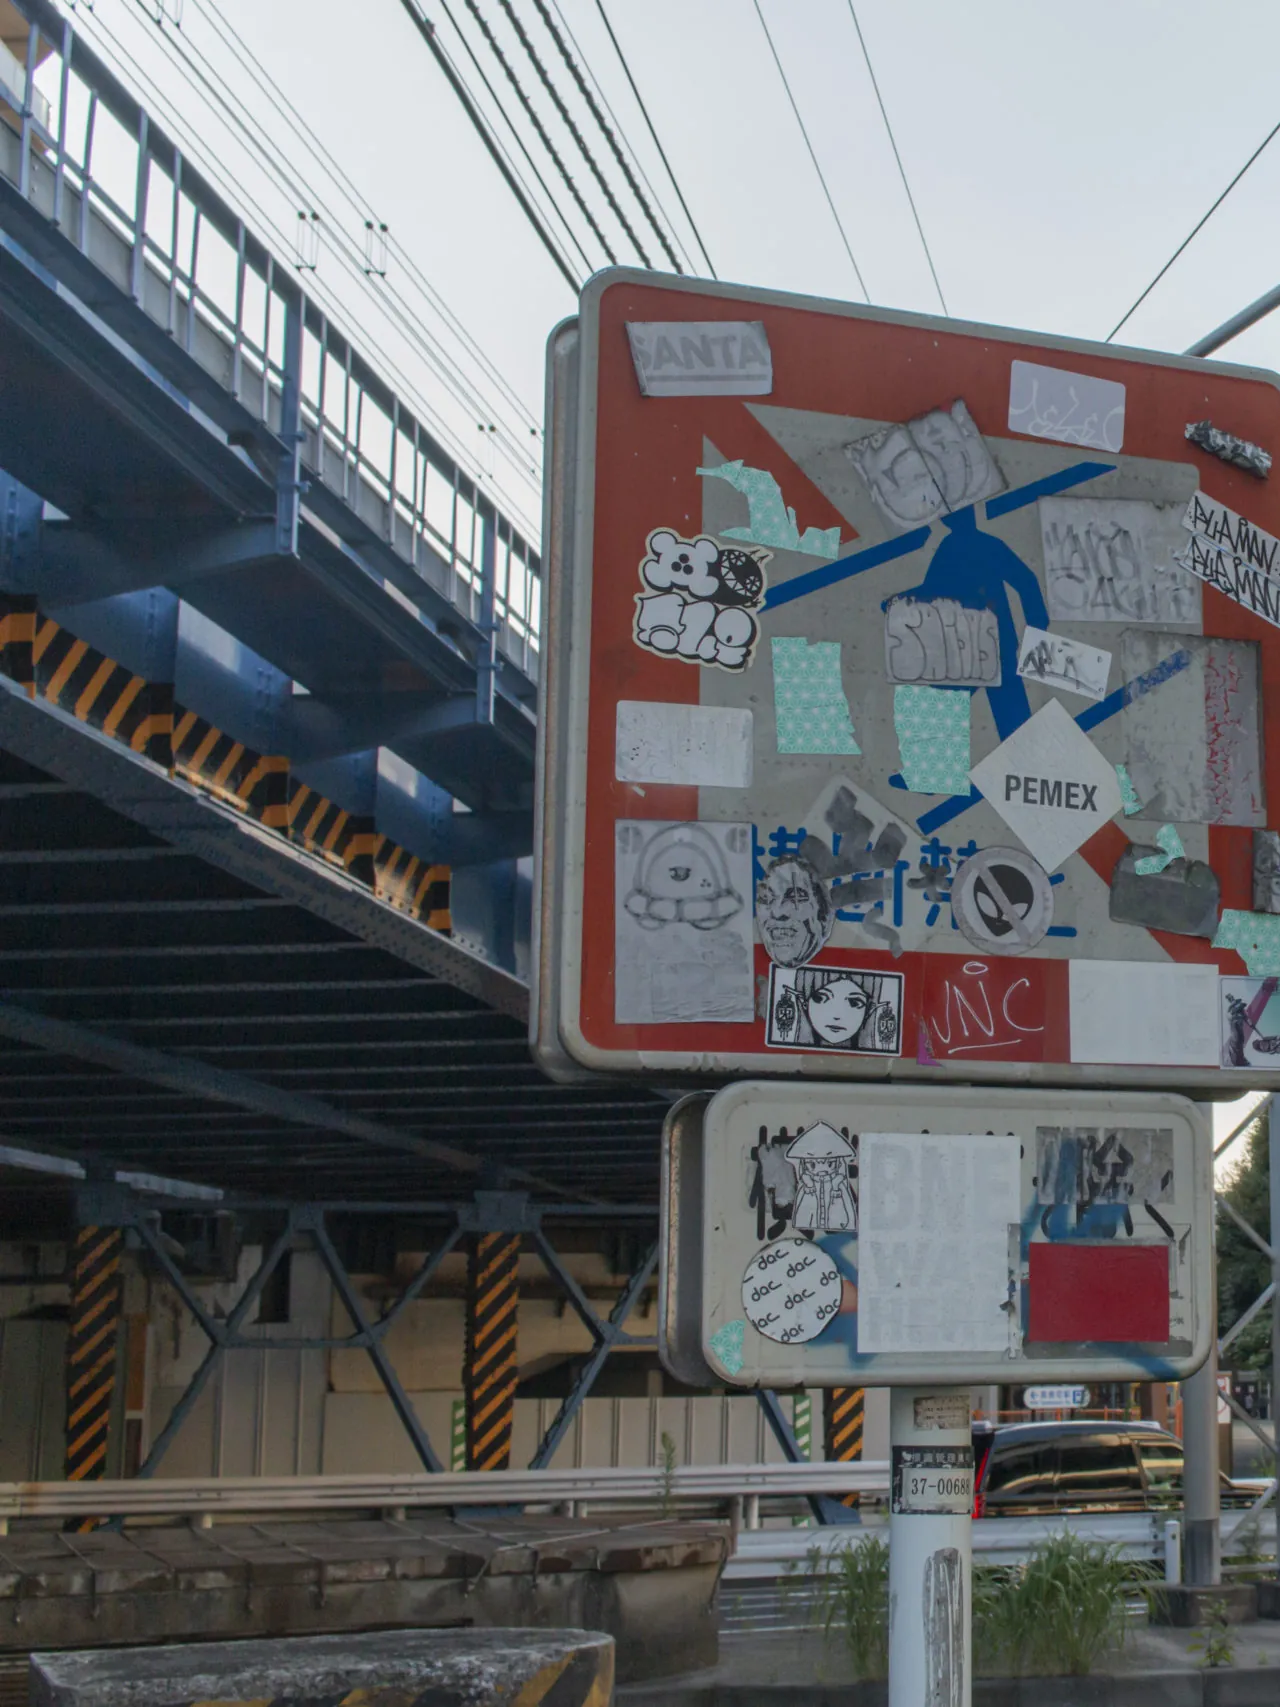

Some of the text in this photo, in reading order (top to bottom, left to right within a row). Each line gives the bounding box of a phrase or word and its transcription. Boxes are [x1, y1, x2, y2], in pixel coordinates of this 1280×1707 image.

[1004, 773, 1098, 812] PEMEX
[758, 1249, 790, 1271] dac
[786, 1256, 817, 1278] dac
[751, 1280, 783, 1302] dac
[784, 1288, 816, 1310] dac
